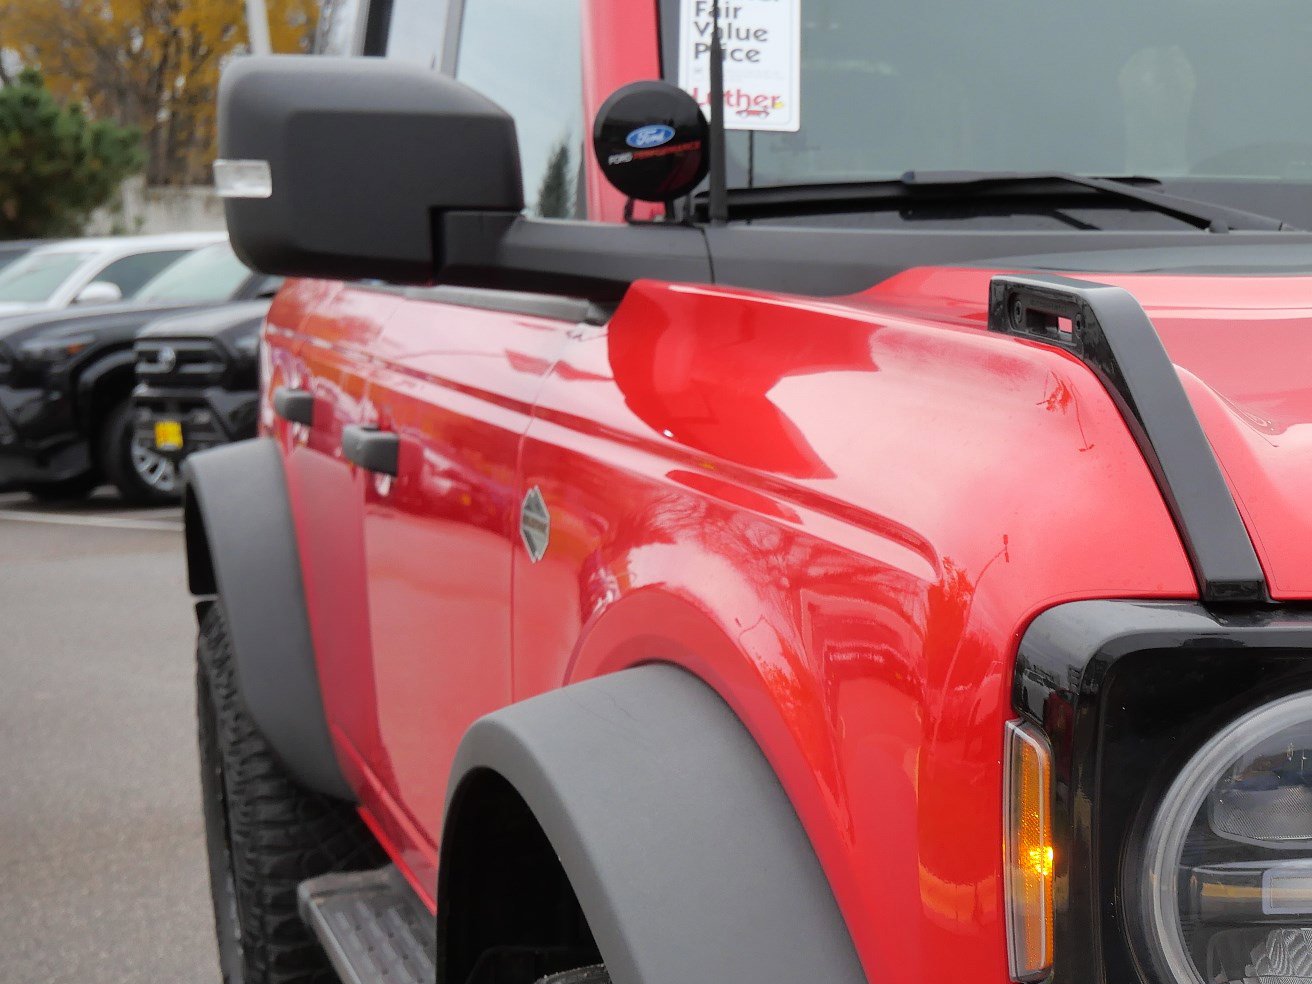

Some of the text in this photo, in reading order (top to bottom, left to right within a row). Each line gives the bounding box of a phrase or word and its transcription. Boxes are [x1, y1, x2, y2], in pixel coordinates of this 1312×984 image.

[694, 0, 743, 19] Fair
[694, 42, 761, 62] Pice
[691, 87, 780, 109] Lther
